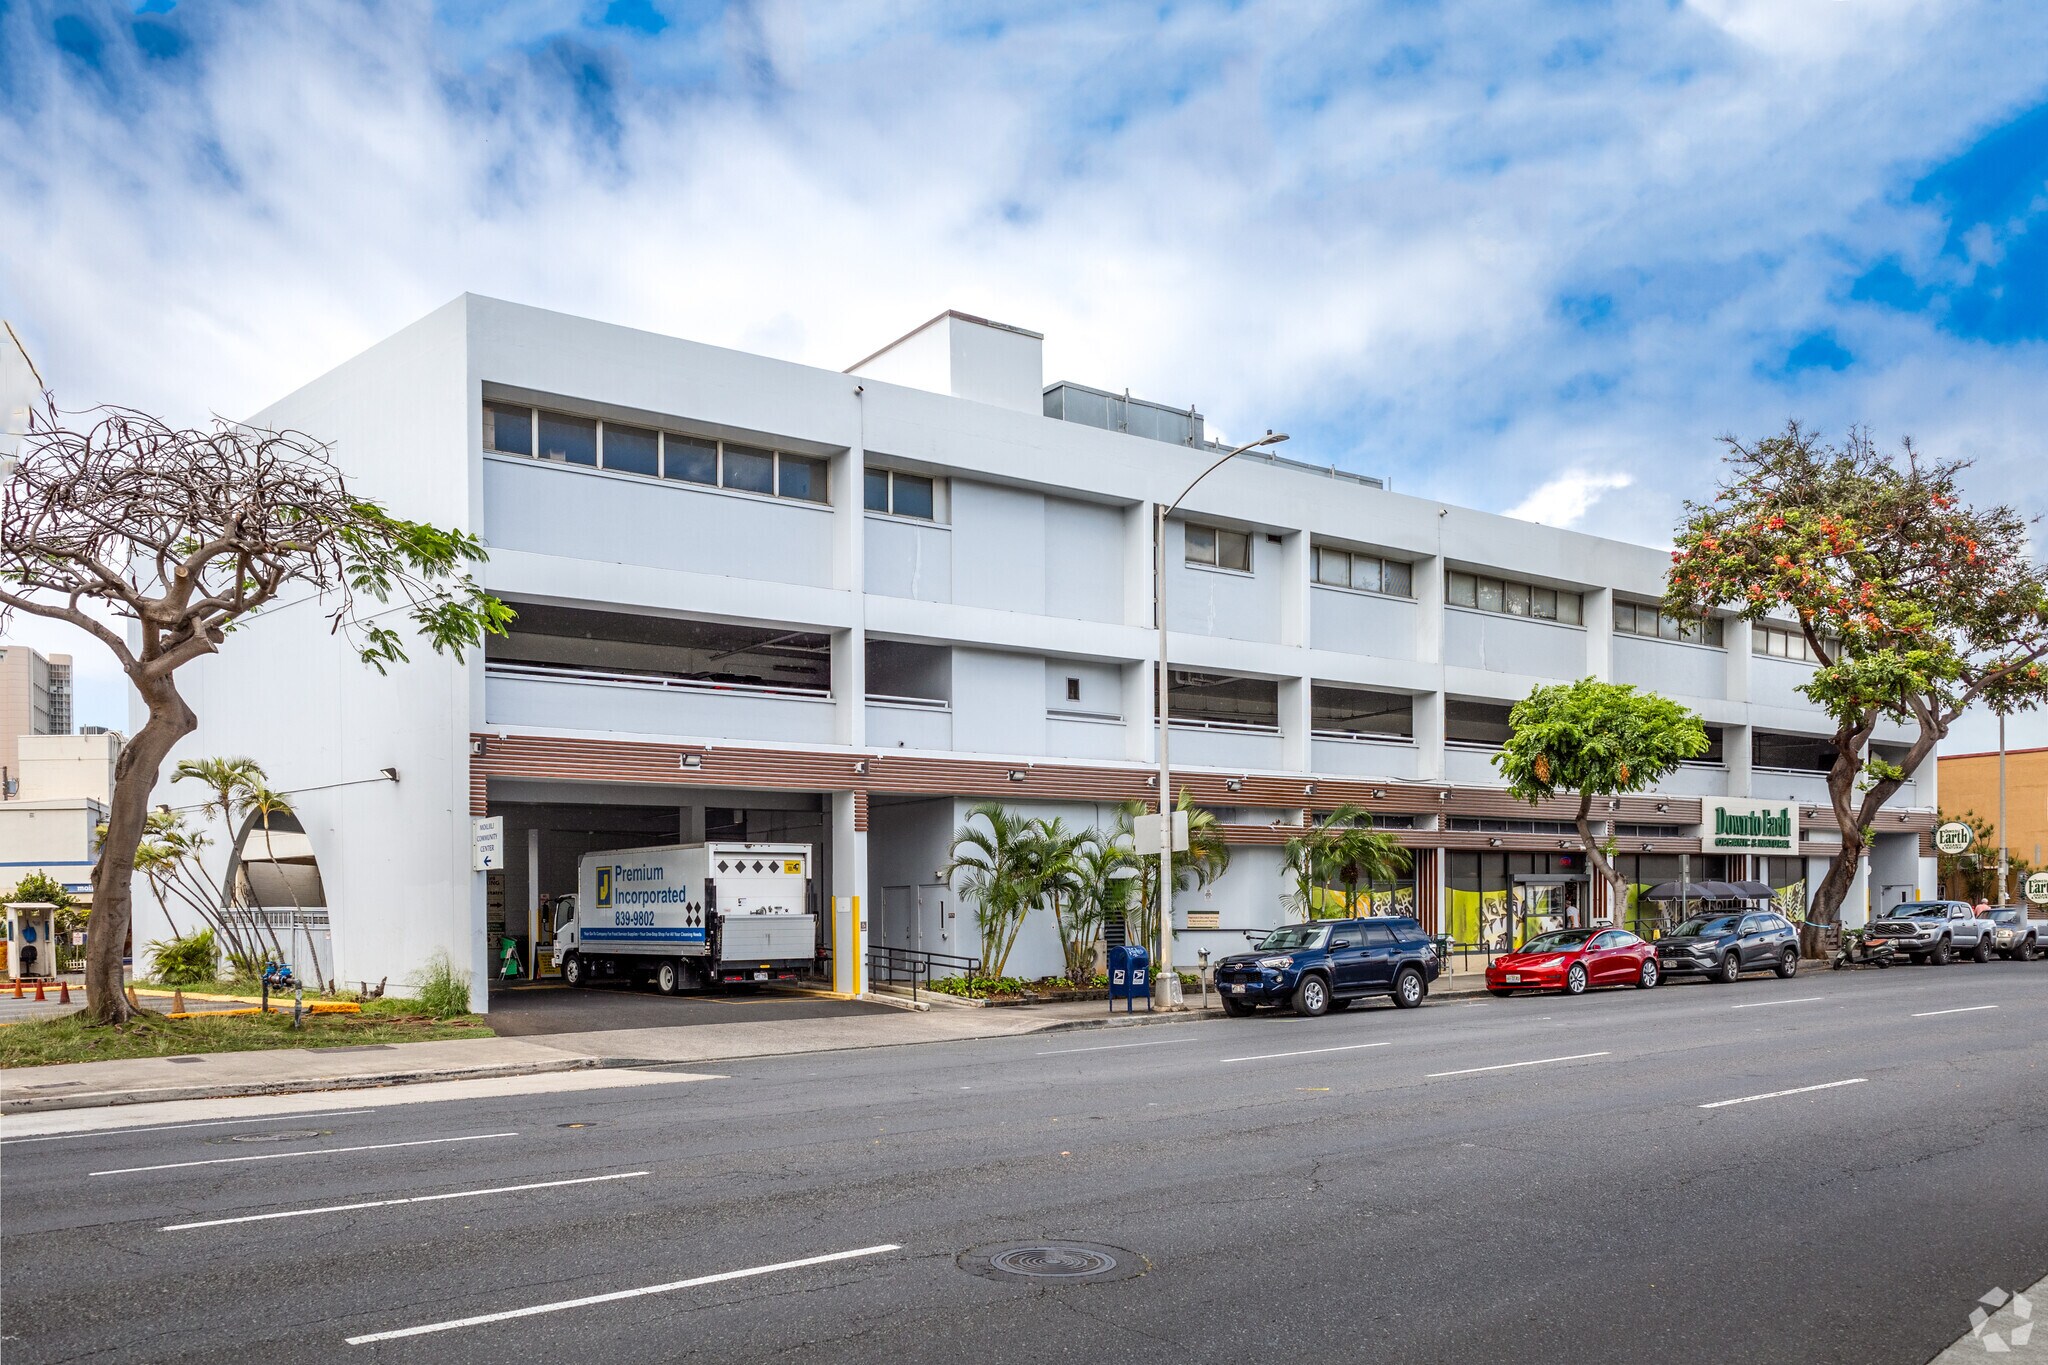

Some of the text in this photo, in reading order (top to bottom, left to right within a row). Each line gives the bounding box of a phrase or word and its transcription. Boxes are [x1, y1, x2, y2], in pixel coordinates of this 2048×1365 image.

[1715, 806, 1749, 835] Down
[1762, 808, 1791, 837] Earth
[1939, 828, 1967, 844] Earth
[615, 864, 663, 881] Premium
[615, 885, 686, 908] Incorporated
[615, 911, 654, 926] 839-9802
